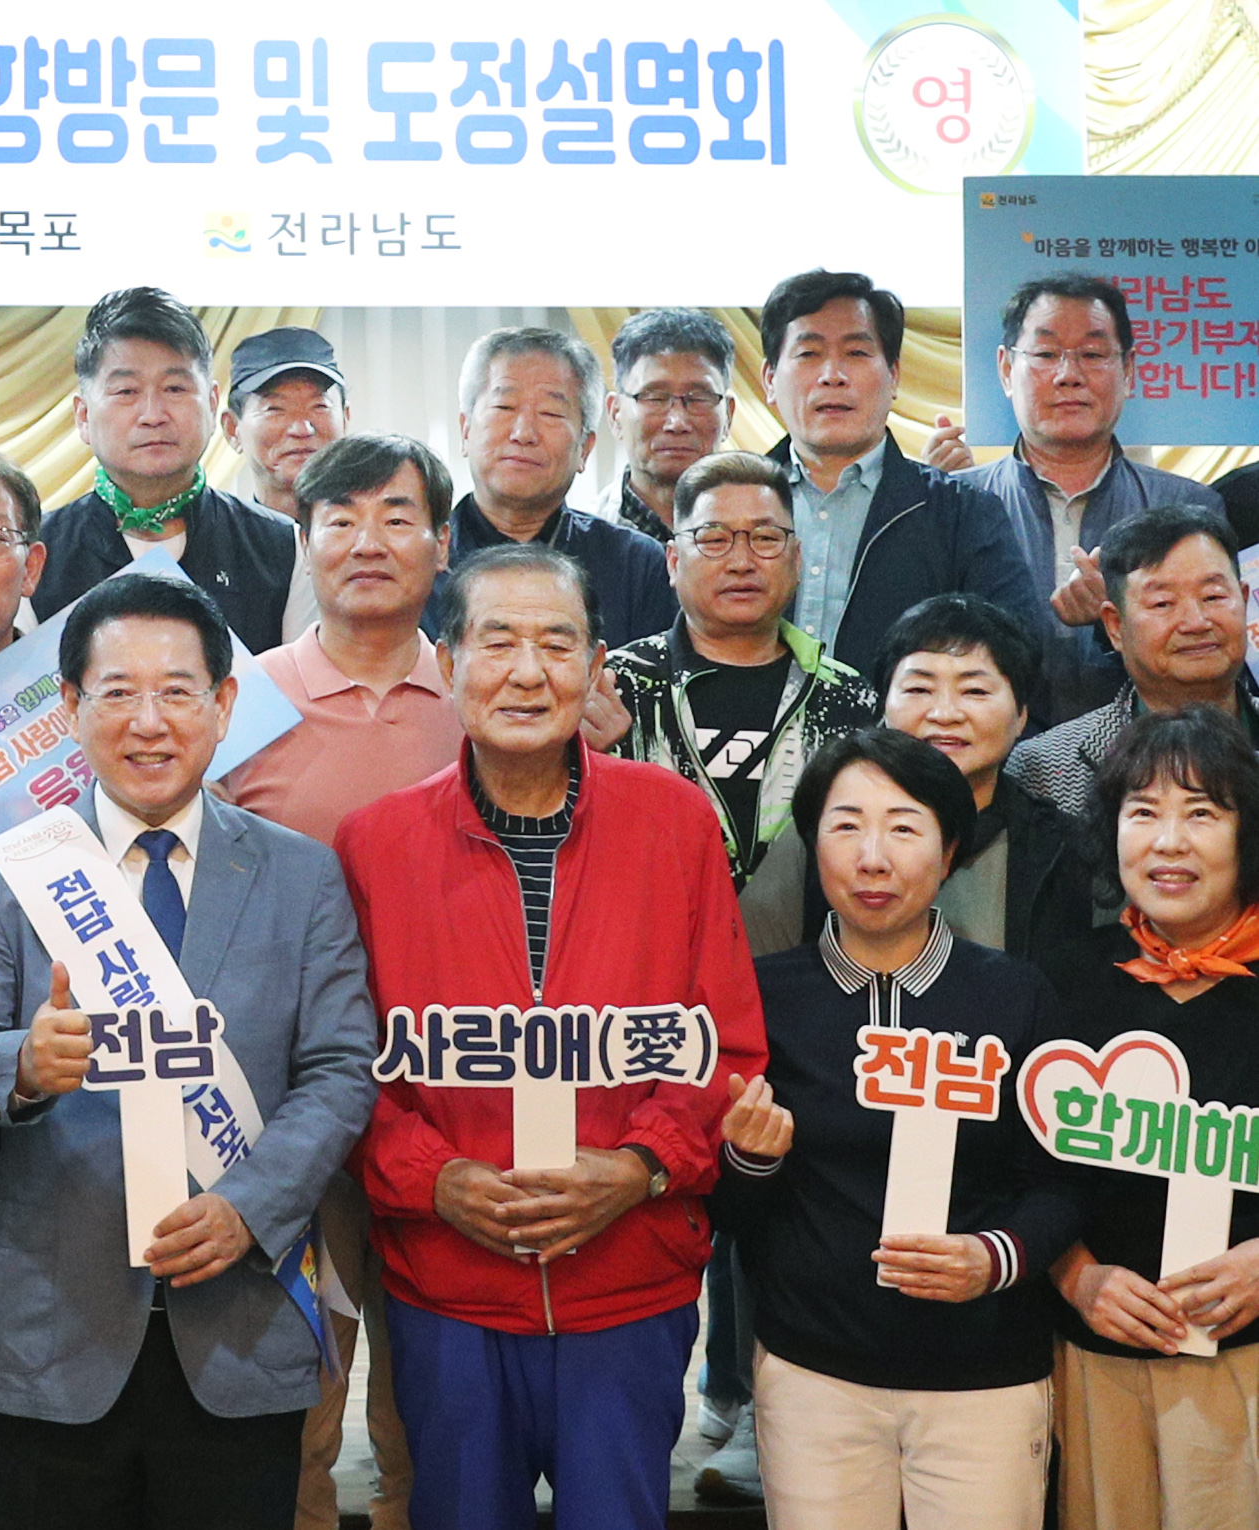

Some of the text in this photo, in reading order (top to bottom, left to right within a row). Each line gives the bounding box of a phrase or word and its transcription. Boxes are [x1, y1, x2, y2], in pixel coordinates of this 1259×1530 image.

[253, 37, 333, 164] 및
[363, 37, 787, 166] 도정설명회
[911, 66, 973, 144] 영
[268, 212, 462, 256] 전라남도
[1034, 237, 1092, 258] 마음을
[1098, 237, 1175, 258] 함께하는
[1181, 237, 1239, 258] 행복한
[1128, 361, 1256, 398] 합니다!
[46, 869, 115, 945] 전남
[86, 1004, 218, 1083] 전남
[377, 1011, 712, 1082] 사랑애(愛)
[861, 1033, 1005, 1115] 전남
